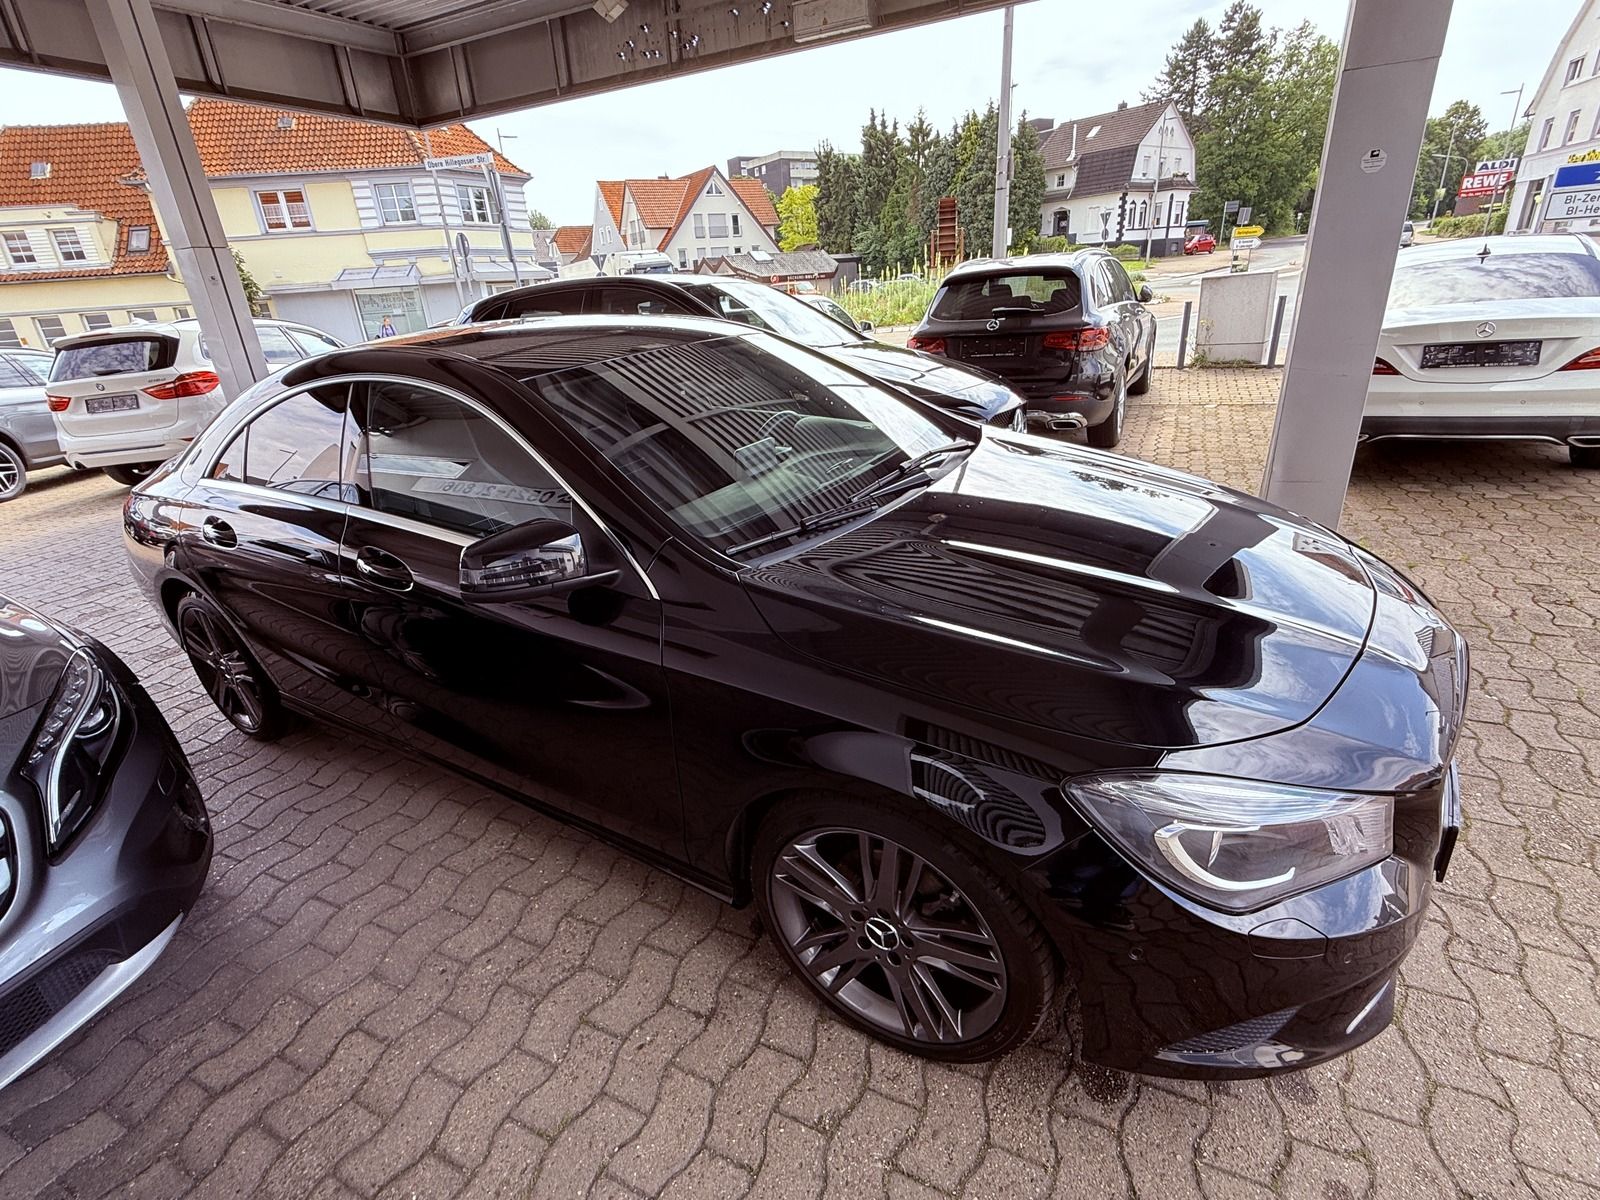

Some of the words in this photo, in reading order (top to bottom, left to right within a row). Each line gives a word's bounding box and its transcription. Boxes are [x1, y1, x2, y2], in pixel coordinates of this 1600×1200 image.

[427, 161, 444, 169] Obere
[1478, 160, 1516, 171] ALDI
[1462, 172, 1509, 189] REWE
